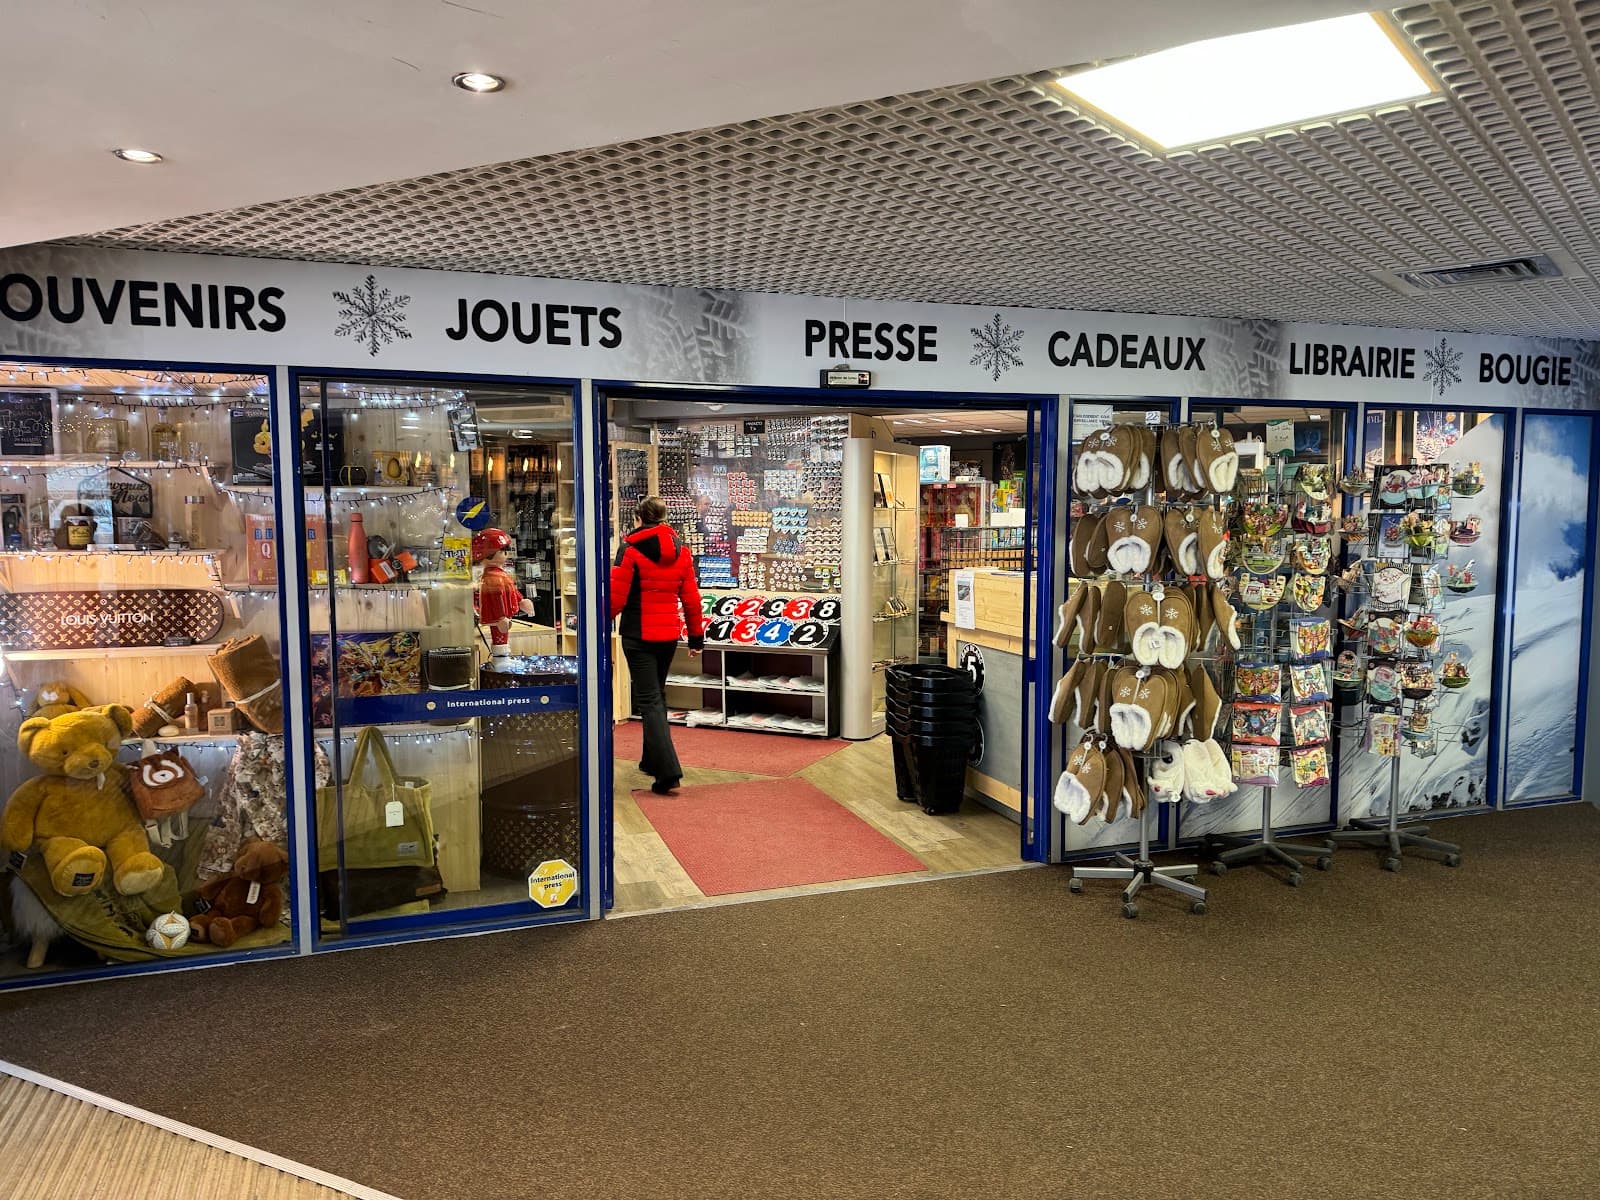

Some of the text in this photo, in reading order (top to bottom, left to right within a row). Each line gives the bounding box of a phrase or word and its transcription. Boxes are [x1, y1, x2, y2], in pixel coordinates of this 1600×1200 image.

[0, 272, 286, 332] OUVENIRS
[446, 298, 622, 348] JOUETS
[805, 319, 938, 362] PRESSE
[1047, 330, 1207, 371] CADEAUX
[1289, 342, 1416, 379] LIBRAIRIE
[1479, 352, 1573, 387] BOUGIE
[721, 599, 738, 615] 6
[742, 600, 760, 616] 2
[769, 600, 785, 617] 9
[791, 601, 809, 618] 3
[818, 601, 836, 618] 8
[60, 612, 154, 626] LOUIS VUITTON
[718, 622, 729, 638] 1
[741, 623, 757, 639] 3
[764, 623, 780, 641] 4
[798, 625, 817, 642] 2
[967, 655, 977, 682] 5
[447, 698, 530, 708] International press
[530, 872, 575, 884] International
[543, 882, 562, 891] press
